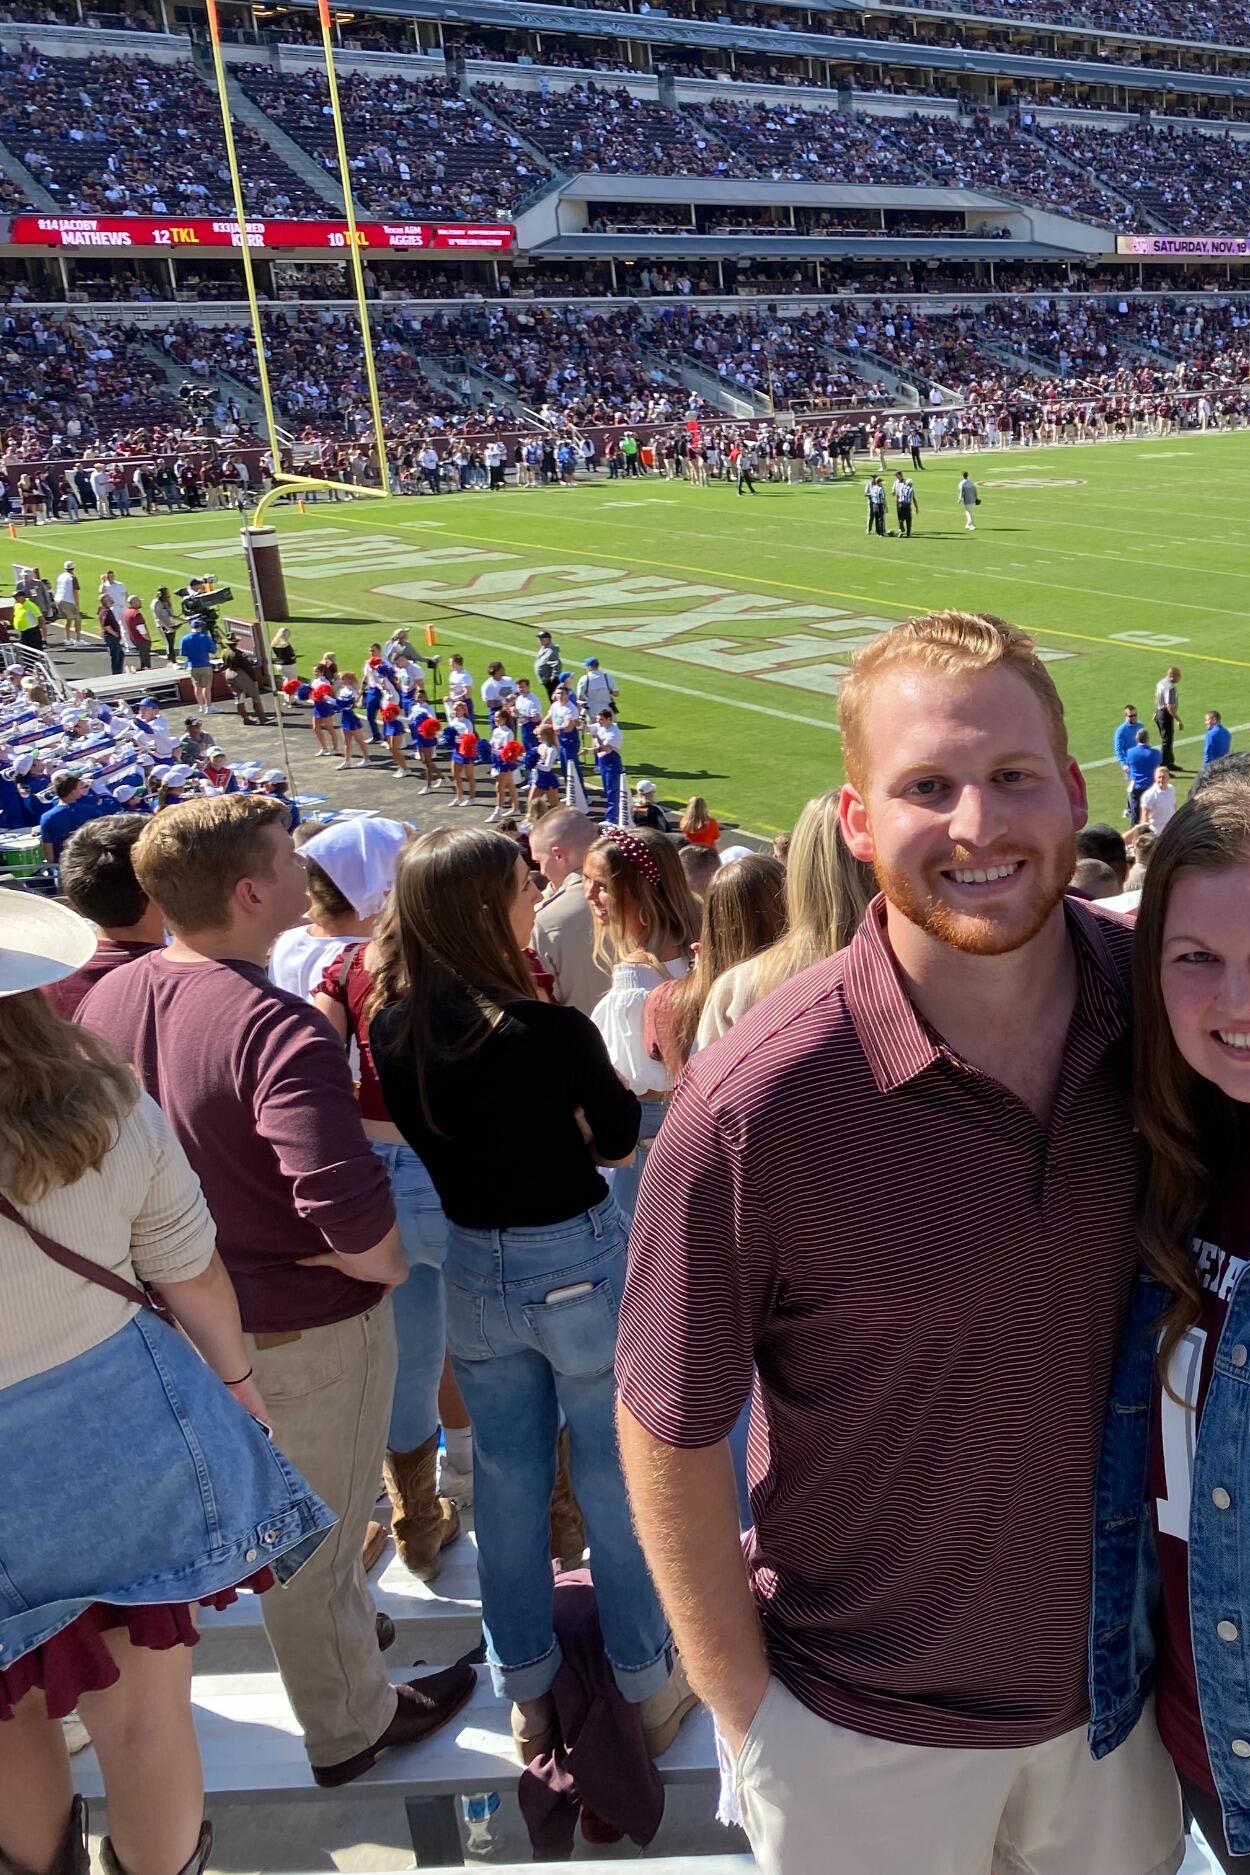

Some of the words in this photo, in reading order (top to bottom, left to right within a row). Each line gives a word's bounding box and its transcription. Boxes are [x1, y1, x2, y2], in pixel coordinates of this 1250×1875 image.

[38, 219, 58, 230] #14
[62, 231, 131, 245] MATHEWS
[152, 229, 171, 244] 12
[170, 228, 200, 243] TKL
[328, 233, 345, 246] 10
[389, 235, 423, 246] AGGIES
[1212, 241, 1235, 253] NOV.
